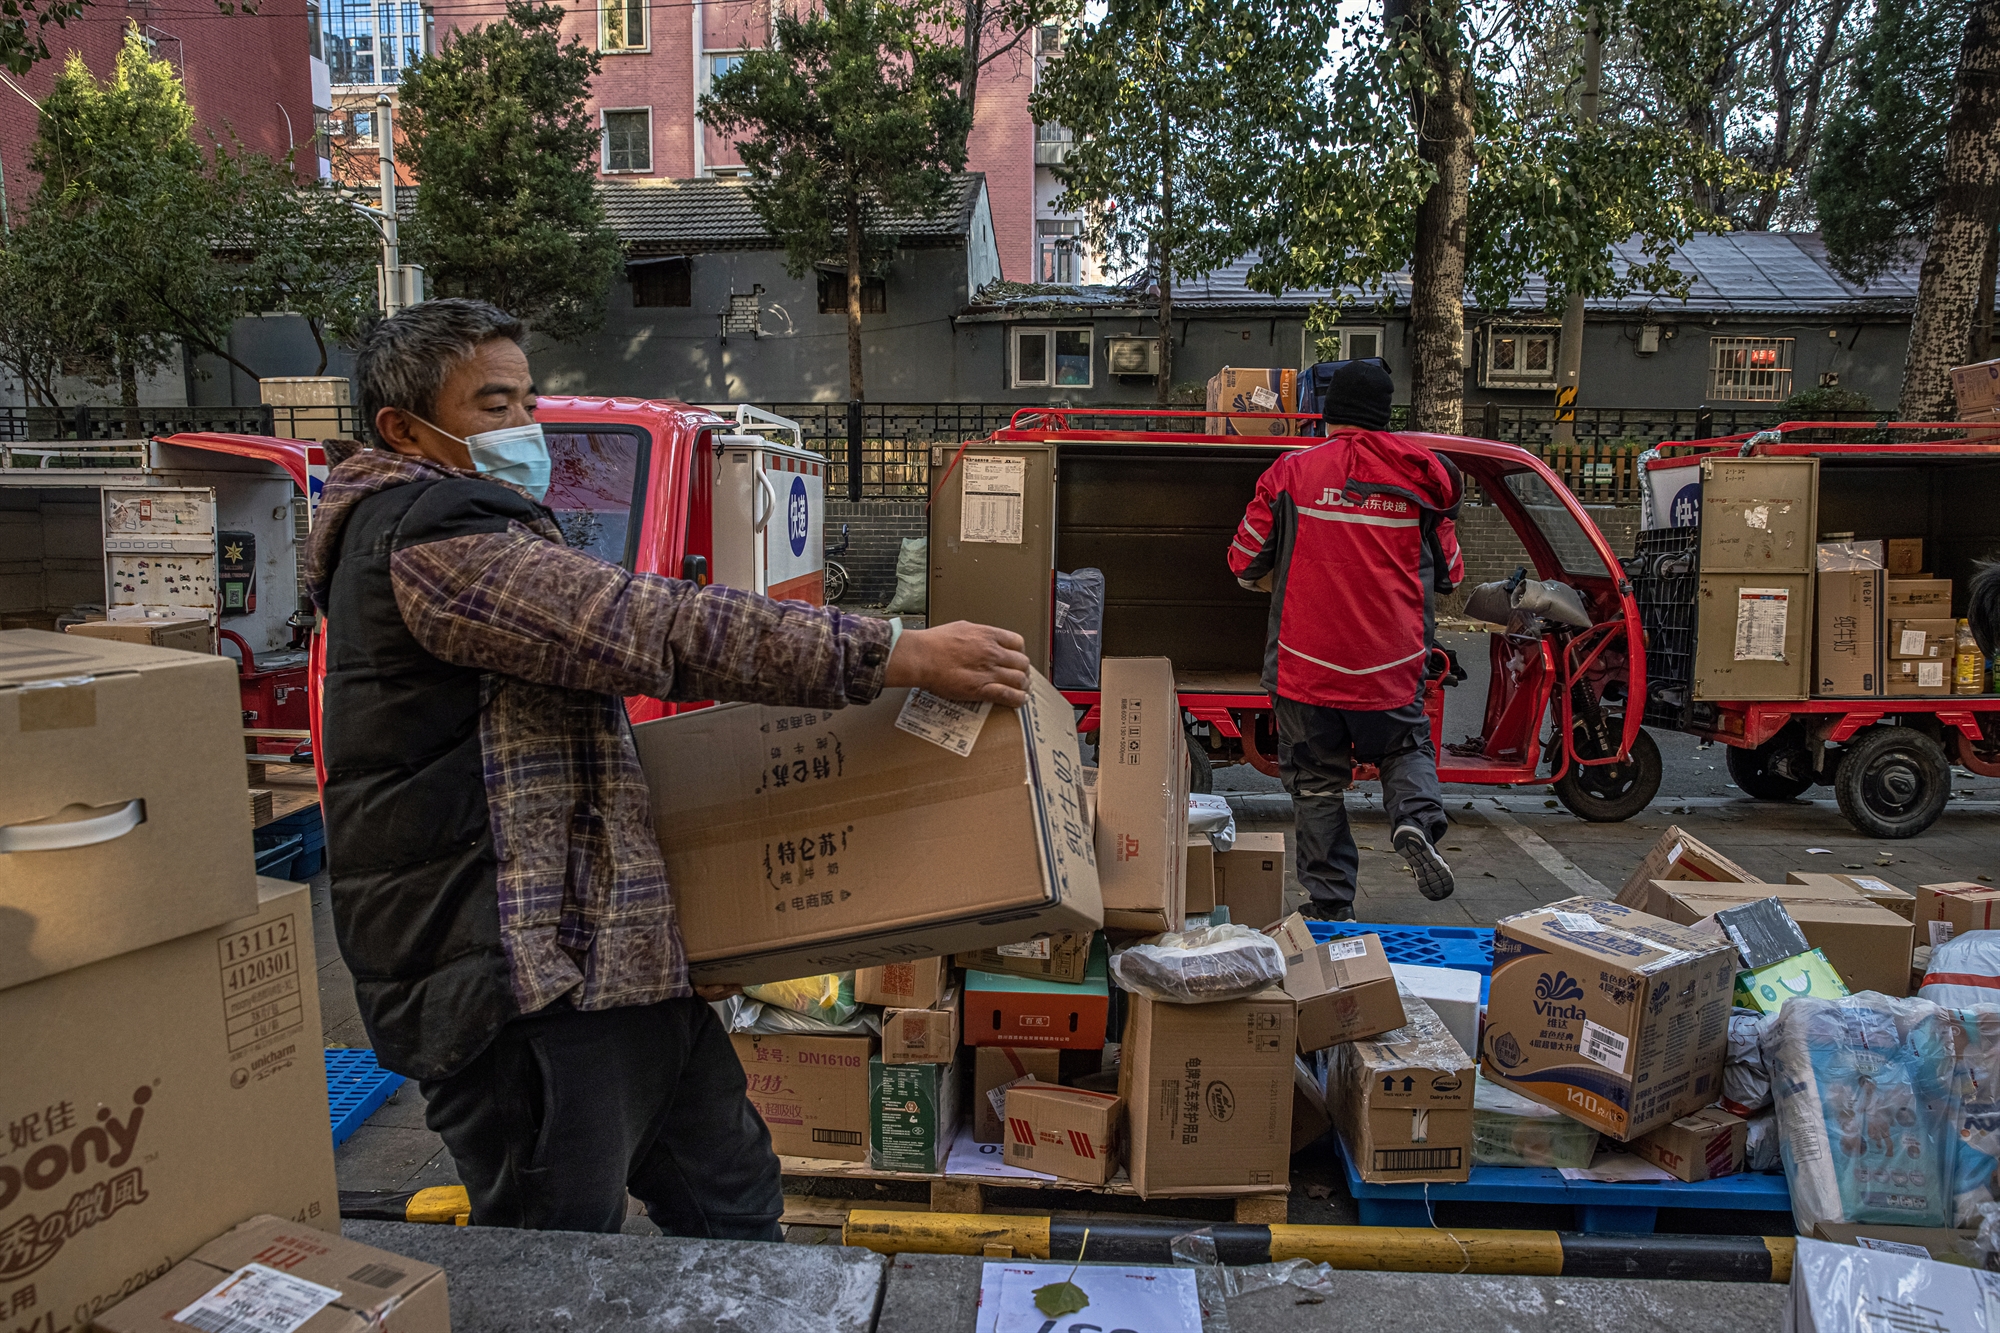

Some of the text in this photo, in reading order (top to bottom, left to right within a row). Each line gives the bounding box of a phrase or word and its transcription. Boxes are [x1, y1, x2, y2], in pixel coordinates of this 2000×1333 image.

[1833, 615, 1857, 652] 纯牛奶
[1822, 677, 1833, 687] 4
[776, 713, 817, 733] 电商版
[772, 755, 831, 788] 特仑苏
[1052, 749, 1086, 859] 纯牛奶
[777, 832, 838, 866] 特仑苏
[1125, 833, 1139, 862] JDL
[791, 890, 835, 911] 电商版
[226, 922, 289, 962] 13112
[229, 951, 291, 990] 4120301
[1600, 971, 1640, 991] 蓝色经
[1533, 999, 1587, 1021] Vinda
[1547, 1017, 1568, 1030] 维达
[1539, 1029, 1575, 1042] 蓝色经典
[251, 1044, 296, 1071] unicharm
[798, 1051, 861, 1068] DN16108
[1181, 1057, 1202, 1145] 龟牌汽车养护用品
[1213, 1087, 1226, 1119] Turtle
[1566, 1087, 1598, 1114] 140
[0, 1100, 77, 1157] 妮佳
[1655, 1144, 1684, 1171] JDL
[0, 1283, 36, 1321] 用
